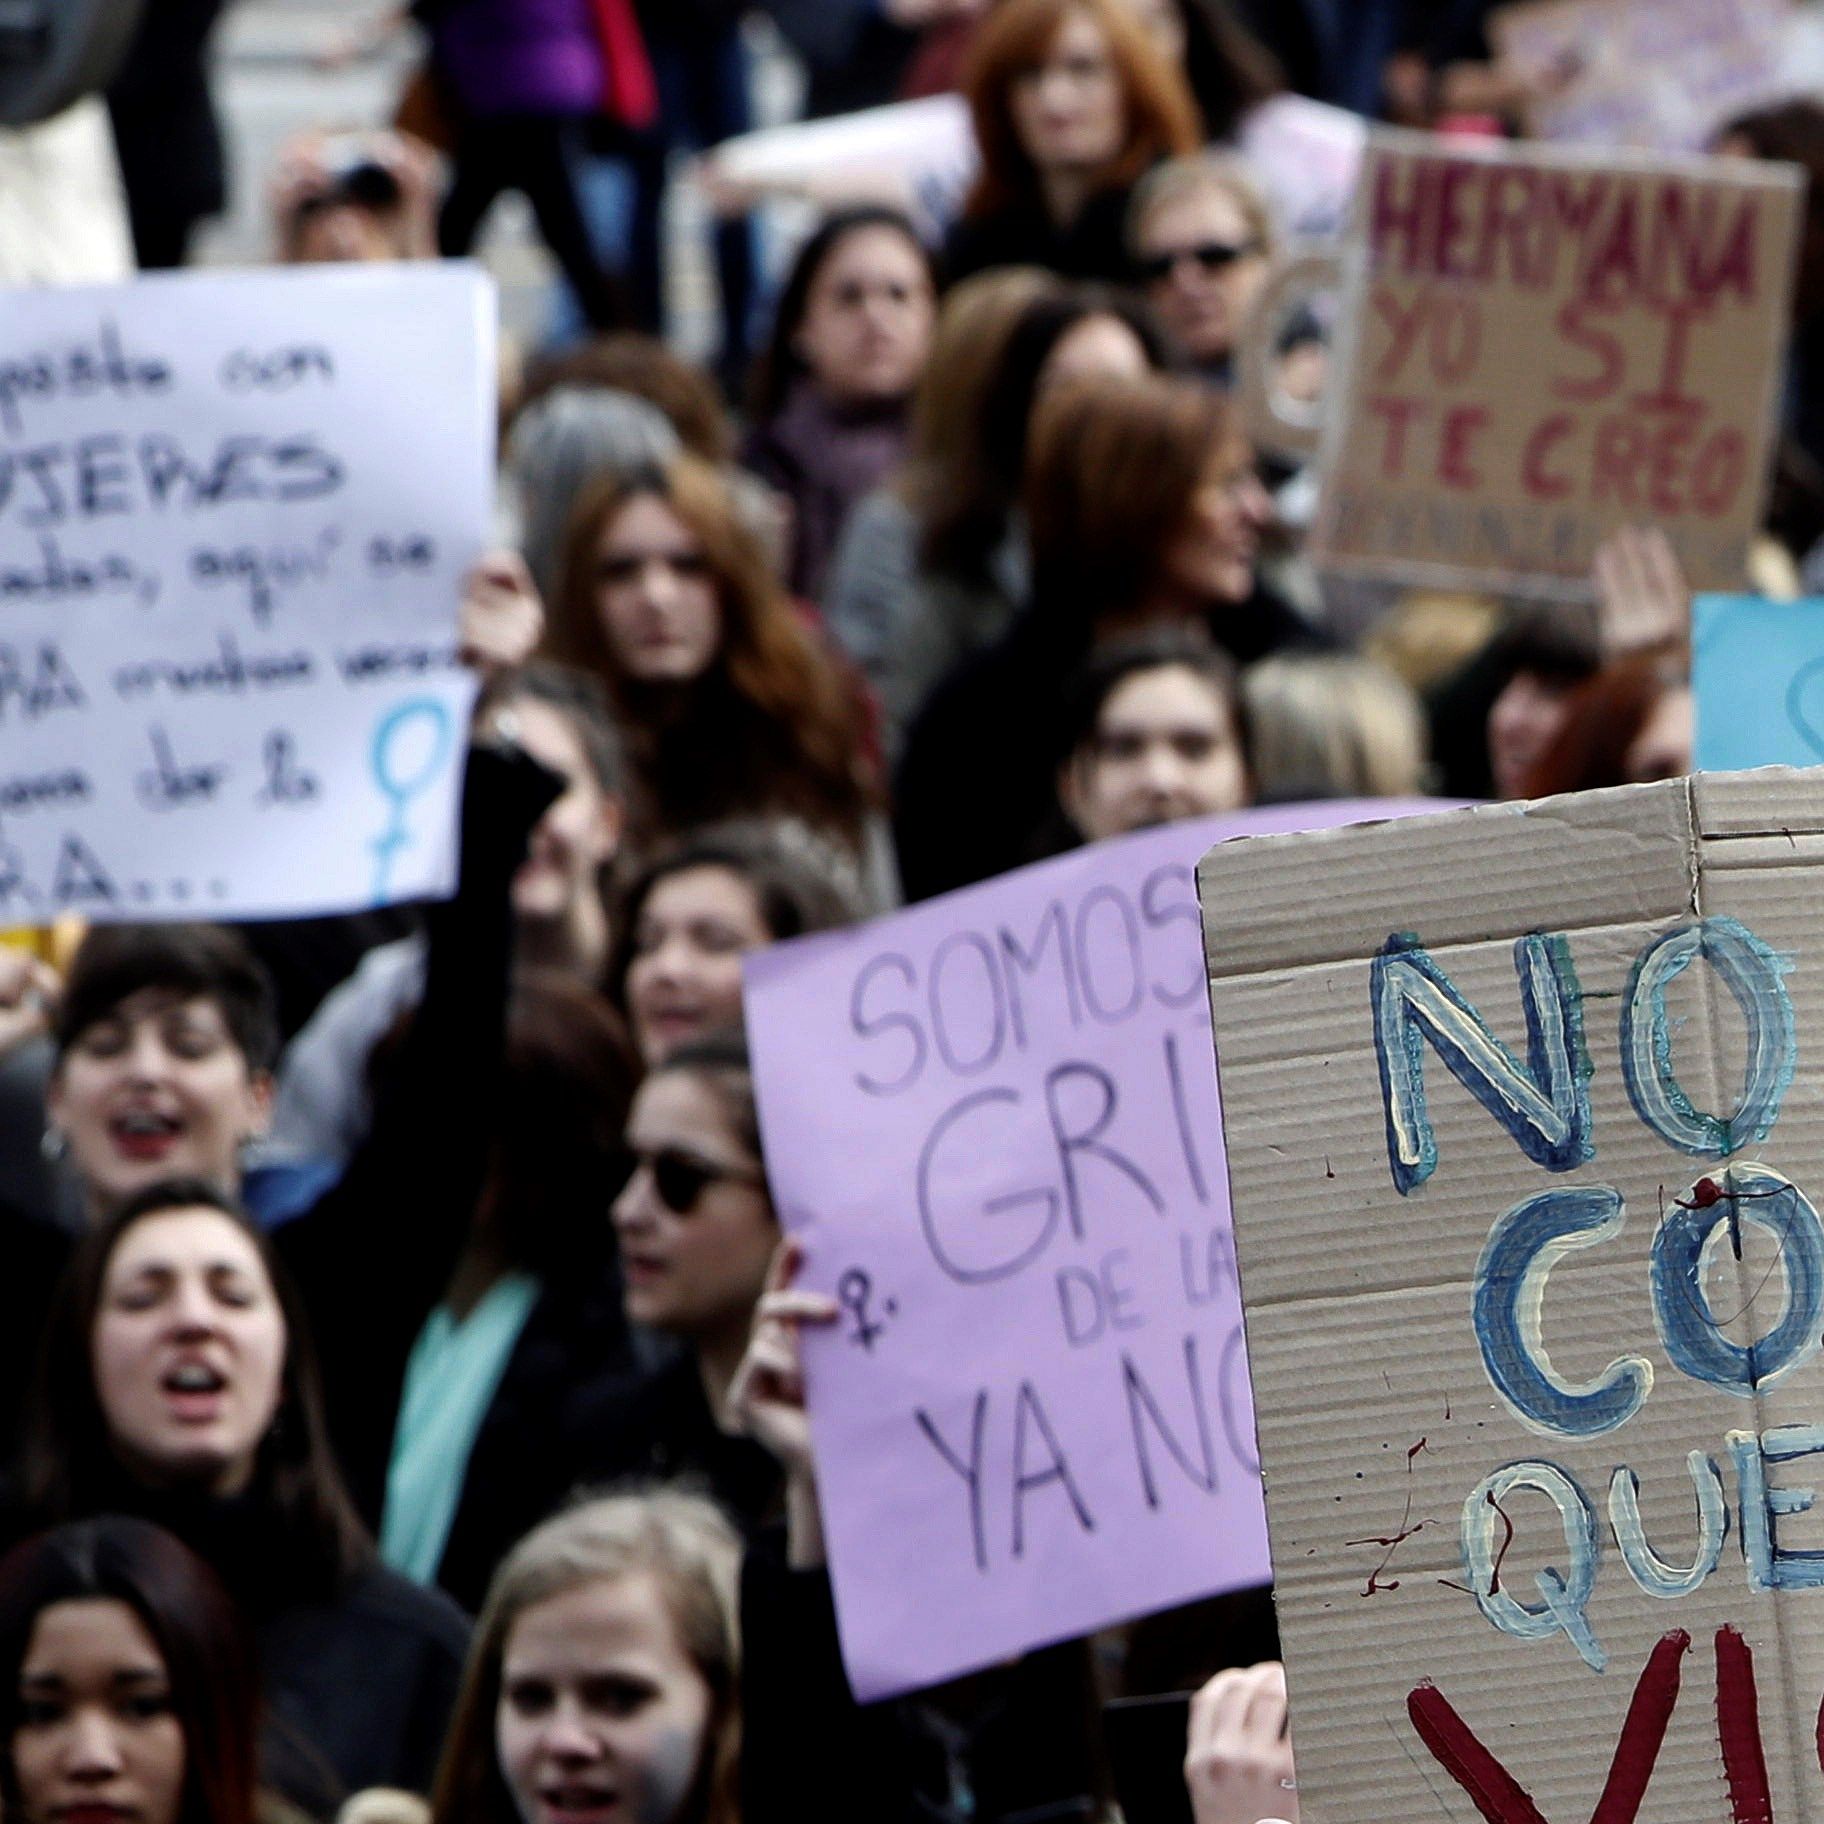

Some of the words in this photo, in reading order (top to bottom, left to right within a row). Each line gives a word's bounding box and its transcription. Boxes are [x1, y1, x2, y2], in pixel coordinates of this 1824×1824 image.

[1368, 157, 1759, 305] HERMANA
[1371, 290, 1482, 385] YO
[0, 434, 343, 527] JERES
[1366, 396, 1489, 487] TE
[1522, 412, 1744, 517] CREO
[849, 862, 1205, 1096] SOMOS
[1369, 914, 1798, 1198] NO
[1054, 1246, 1146, 1347] DE
[914, 1378, 1096, 1572] YA
